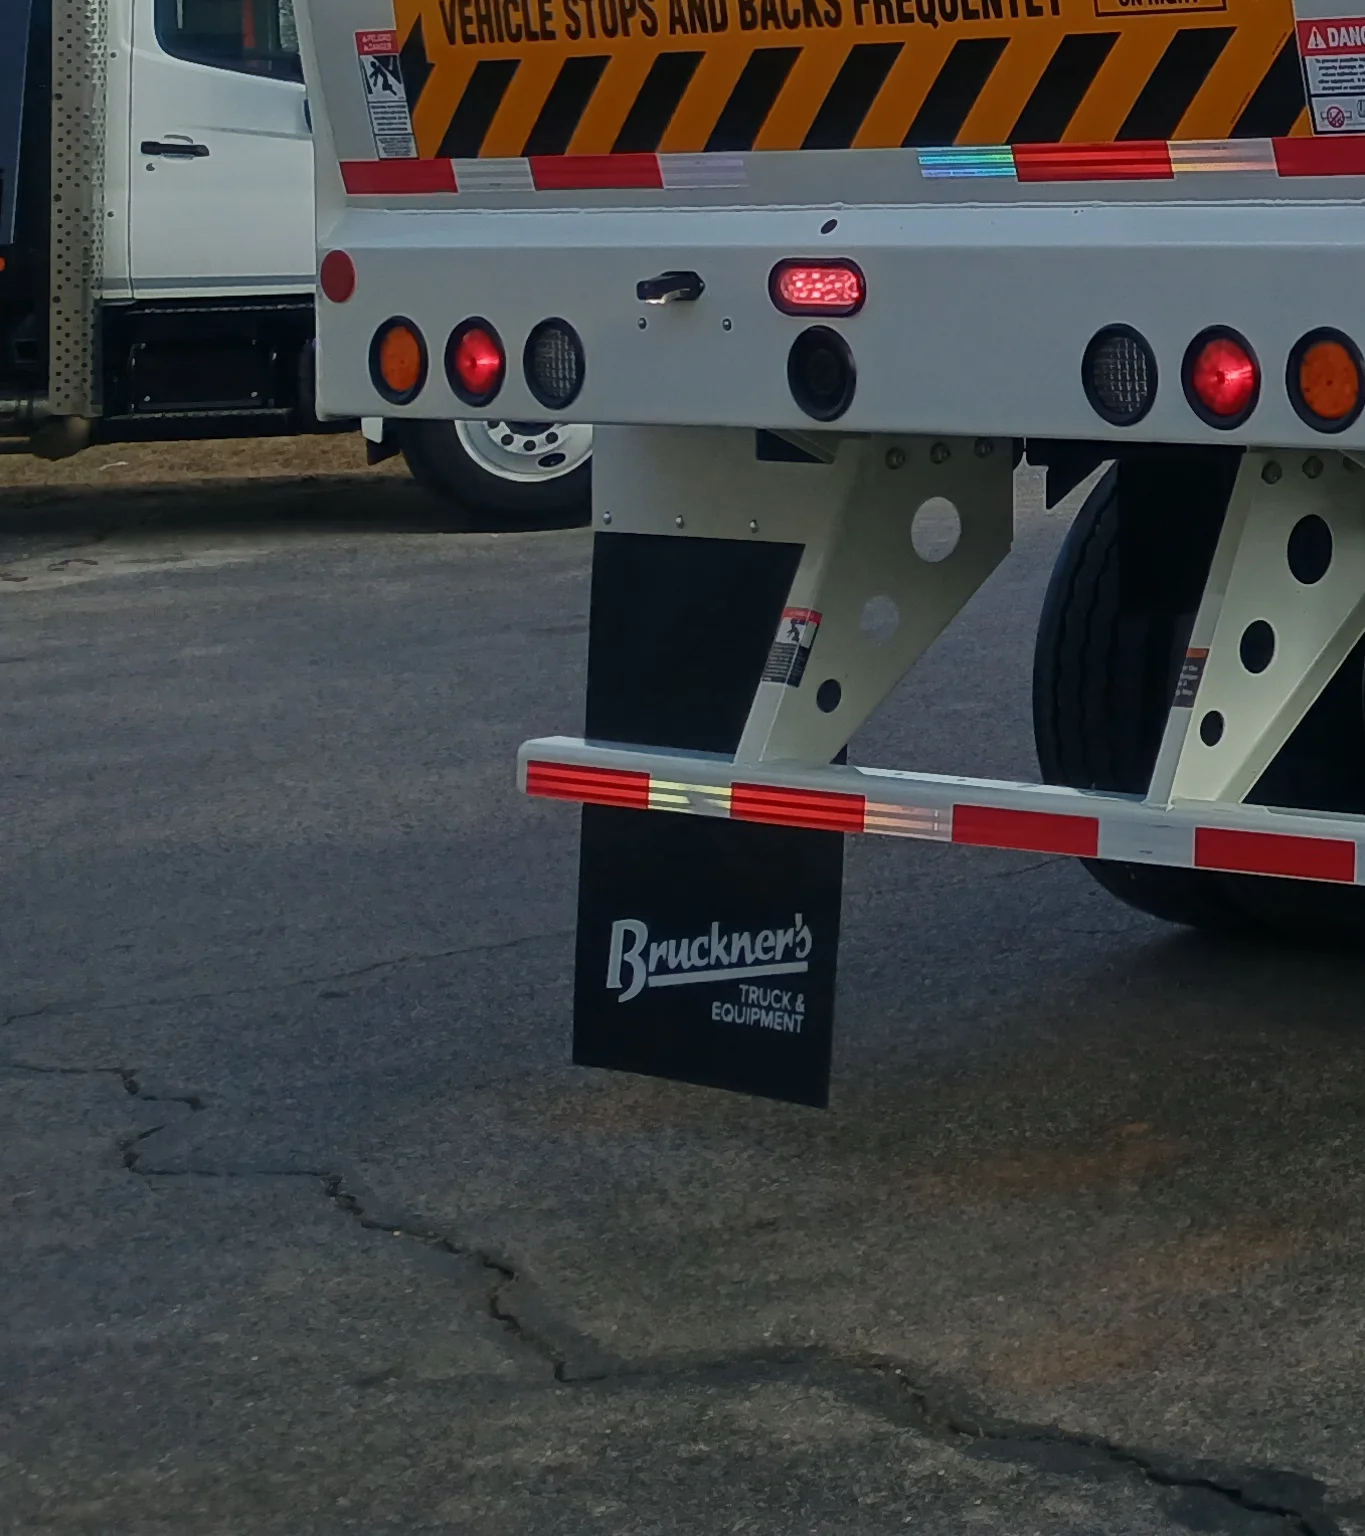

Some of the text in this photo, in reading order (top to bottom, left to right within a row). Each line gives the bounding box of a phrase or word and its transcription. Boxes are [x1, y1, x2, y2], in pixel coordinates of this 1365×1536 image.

[606, 913, 813, 1003] Bruckner's
[738, 984, 805, 1012] TRUCK &
[711, 1001, 805, 1034] EQUIPMENT
